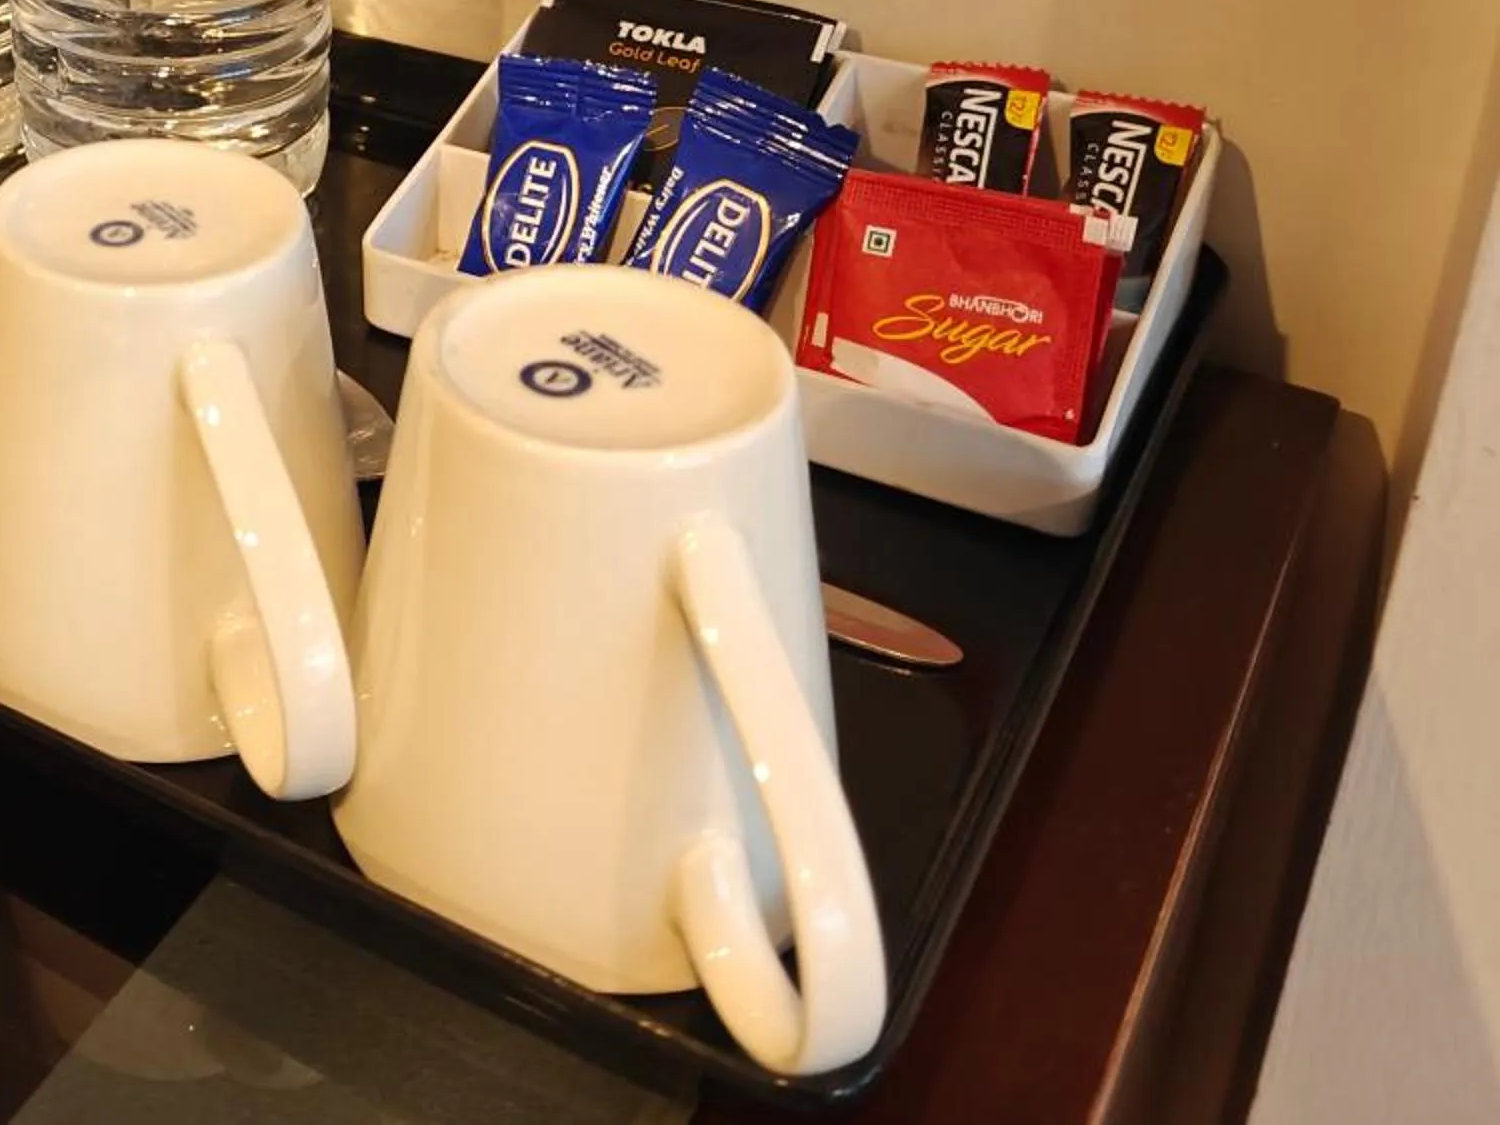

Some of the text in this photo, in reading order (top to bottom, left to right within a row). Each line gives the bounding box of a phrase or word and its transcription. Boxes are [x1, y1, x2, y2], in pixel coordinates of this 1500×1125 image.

[609, 41, 701, 74] Gold Leaf
[617, 20, 707, 54] TOKLA
[946, 87, 1003, 185] NESCA
[504, 156, 558, 268] DELITE
[681, 195, 751, 289] DELIT
[872, 294, 1052, 365] Sugar
